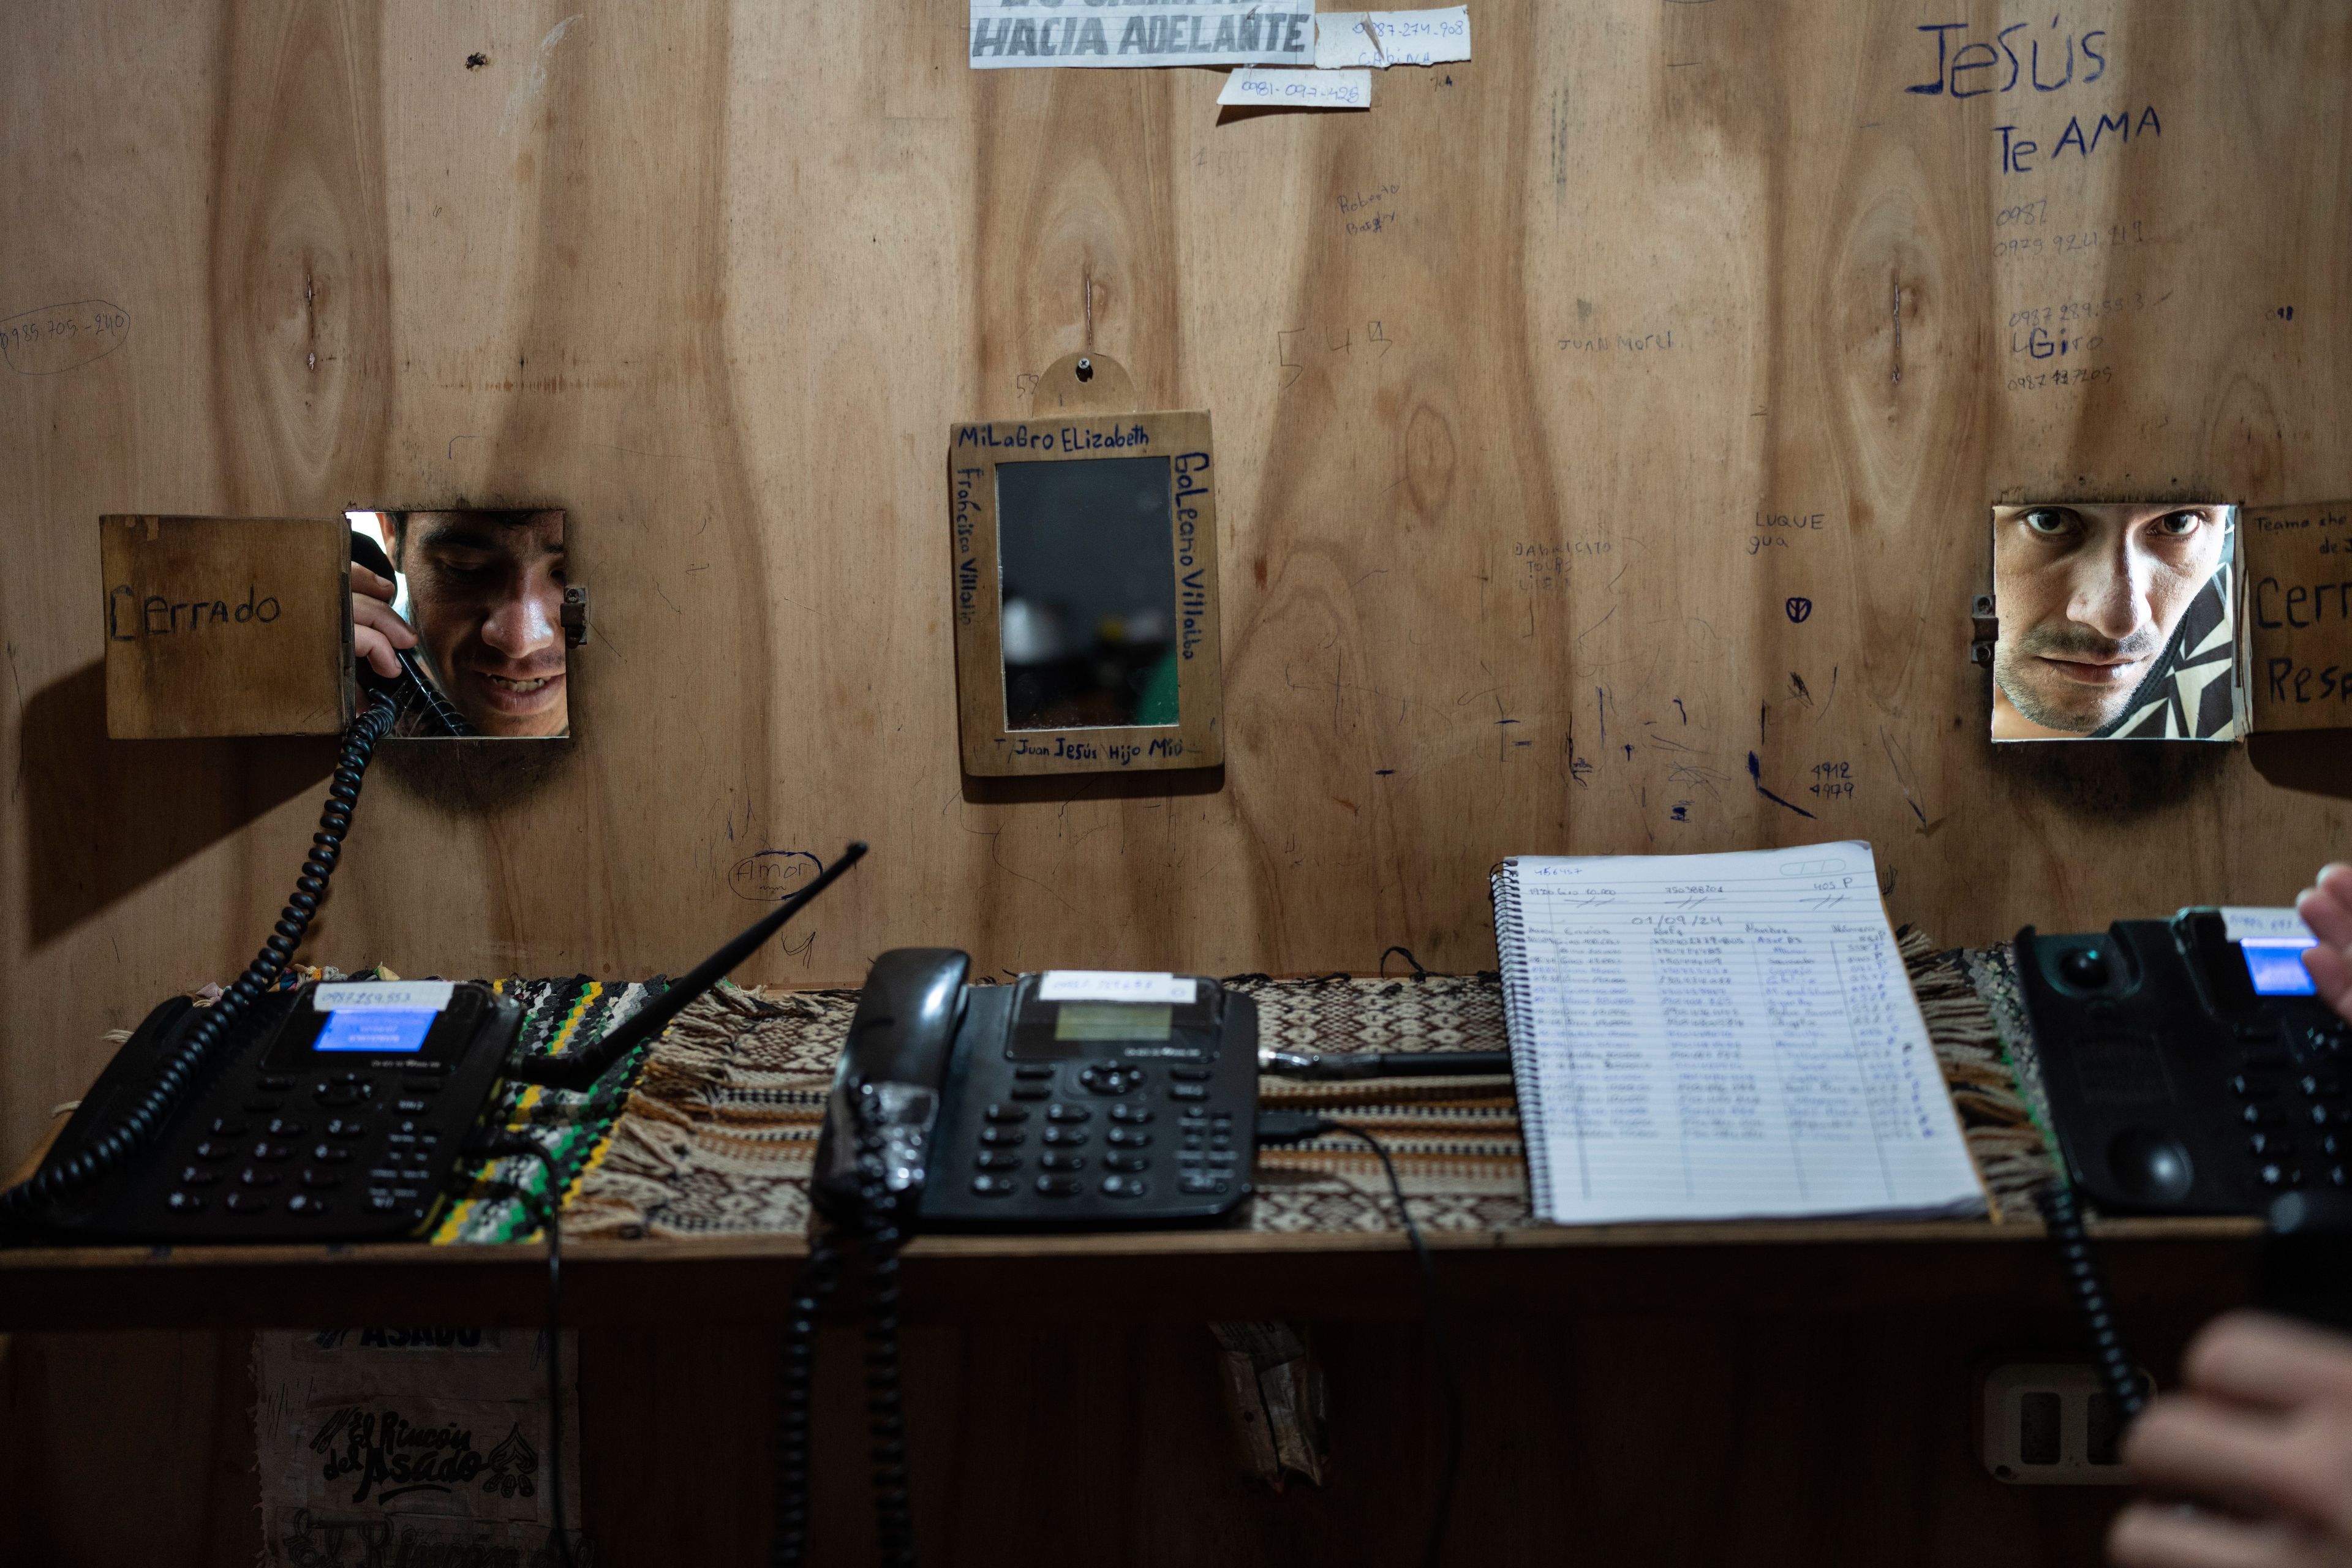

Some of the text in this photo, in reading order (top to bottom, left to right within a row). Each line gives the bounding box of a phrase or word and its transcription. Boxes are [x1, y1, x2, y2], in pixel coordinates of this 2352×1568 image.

[973, 13, 1311, 56] HACIA ADELANTE
[1992, 106, 2162, 175] Te AMA
[1755, 512, 1825, 530] LUQUE
